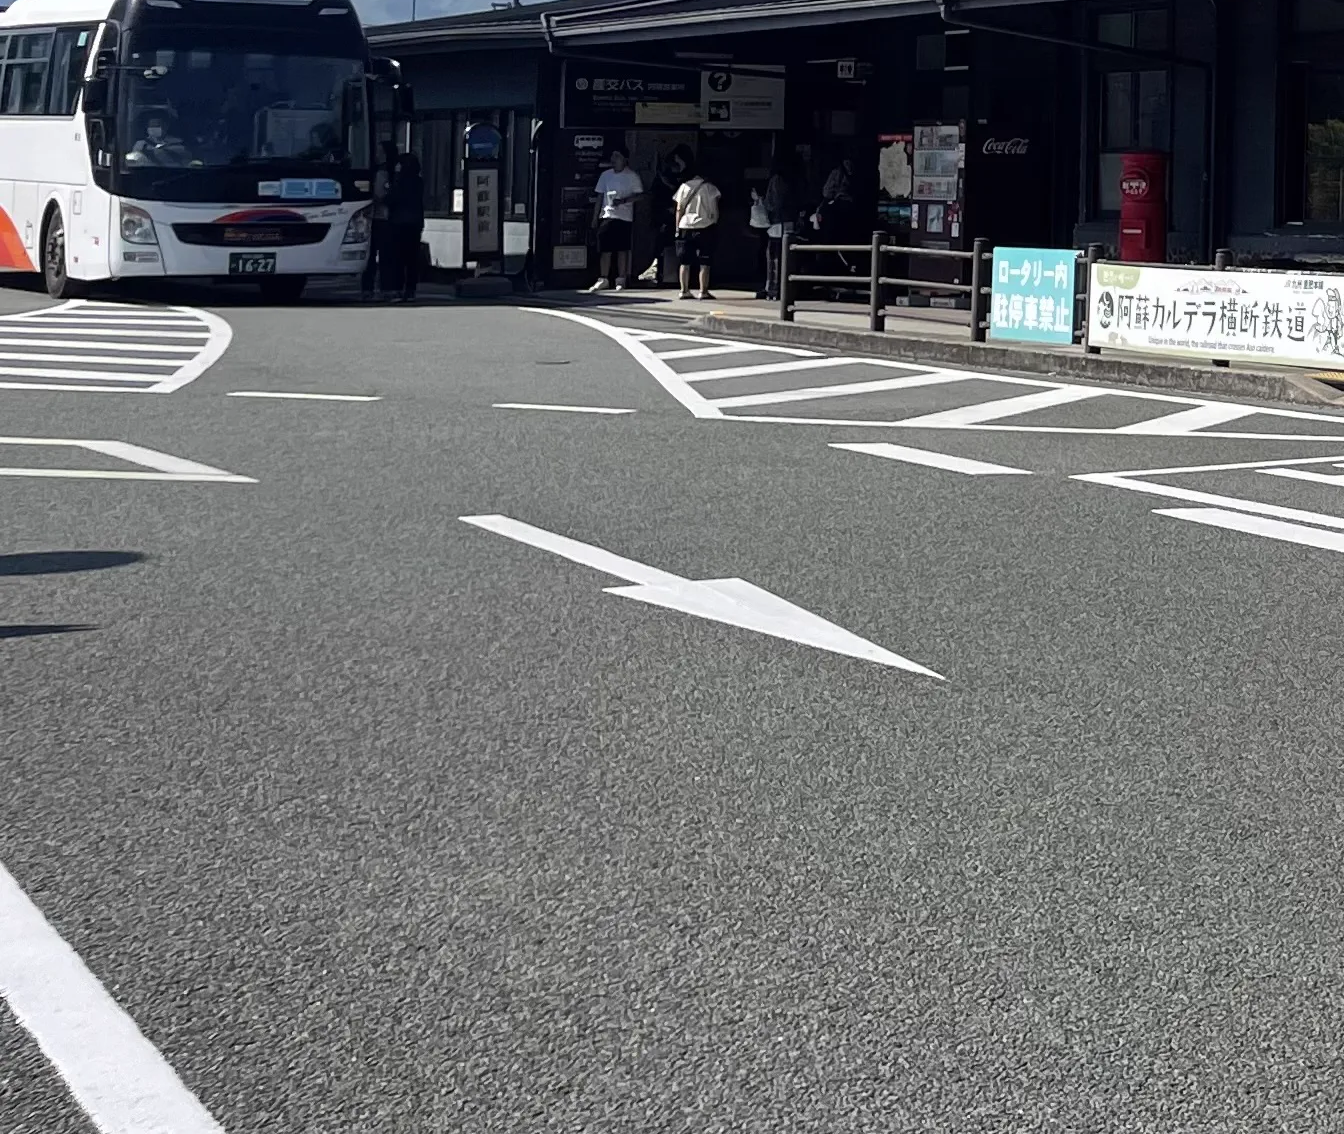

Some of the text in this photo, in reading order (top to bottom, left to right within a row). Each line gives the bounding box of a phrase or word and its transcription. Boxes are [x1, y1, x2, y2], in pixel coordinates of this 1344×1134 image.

[999, 258, 1069, 290] ロータリー内
[993, 293, 1070, 333] 駐停車禁止
[1116, 293, 1307, 342] 阿蘇カルデラ横断鉄道
